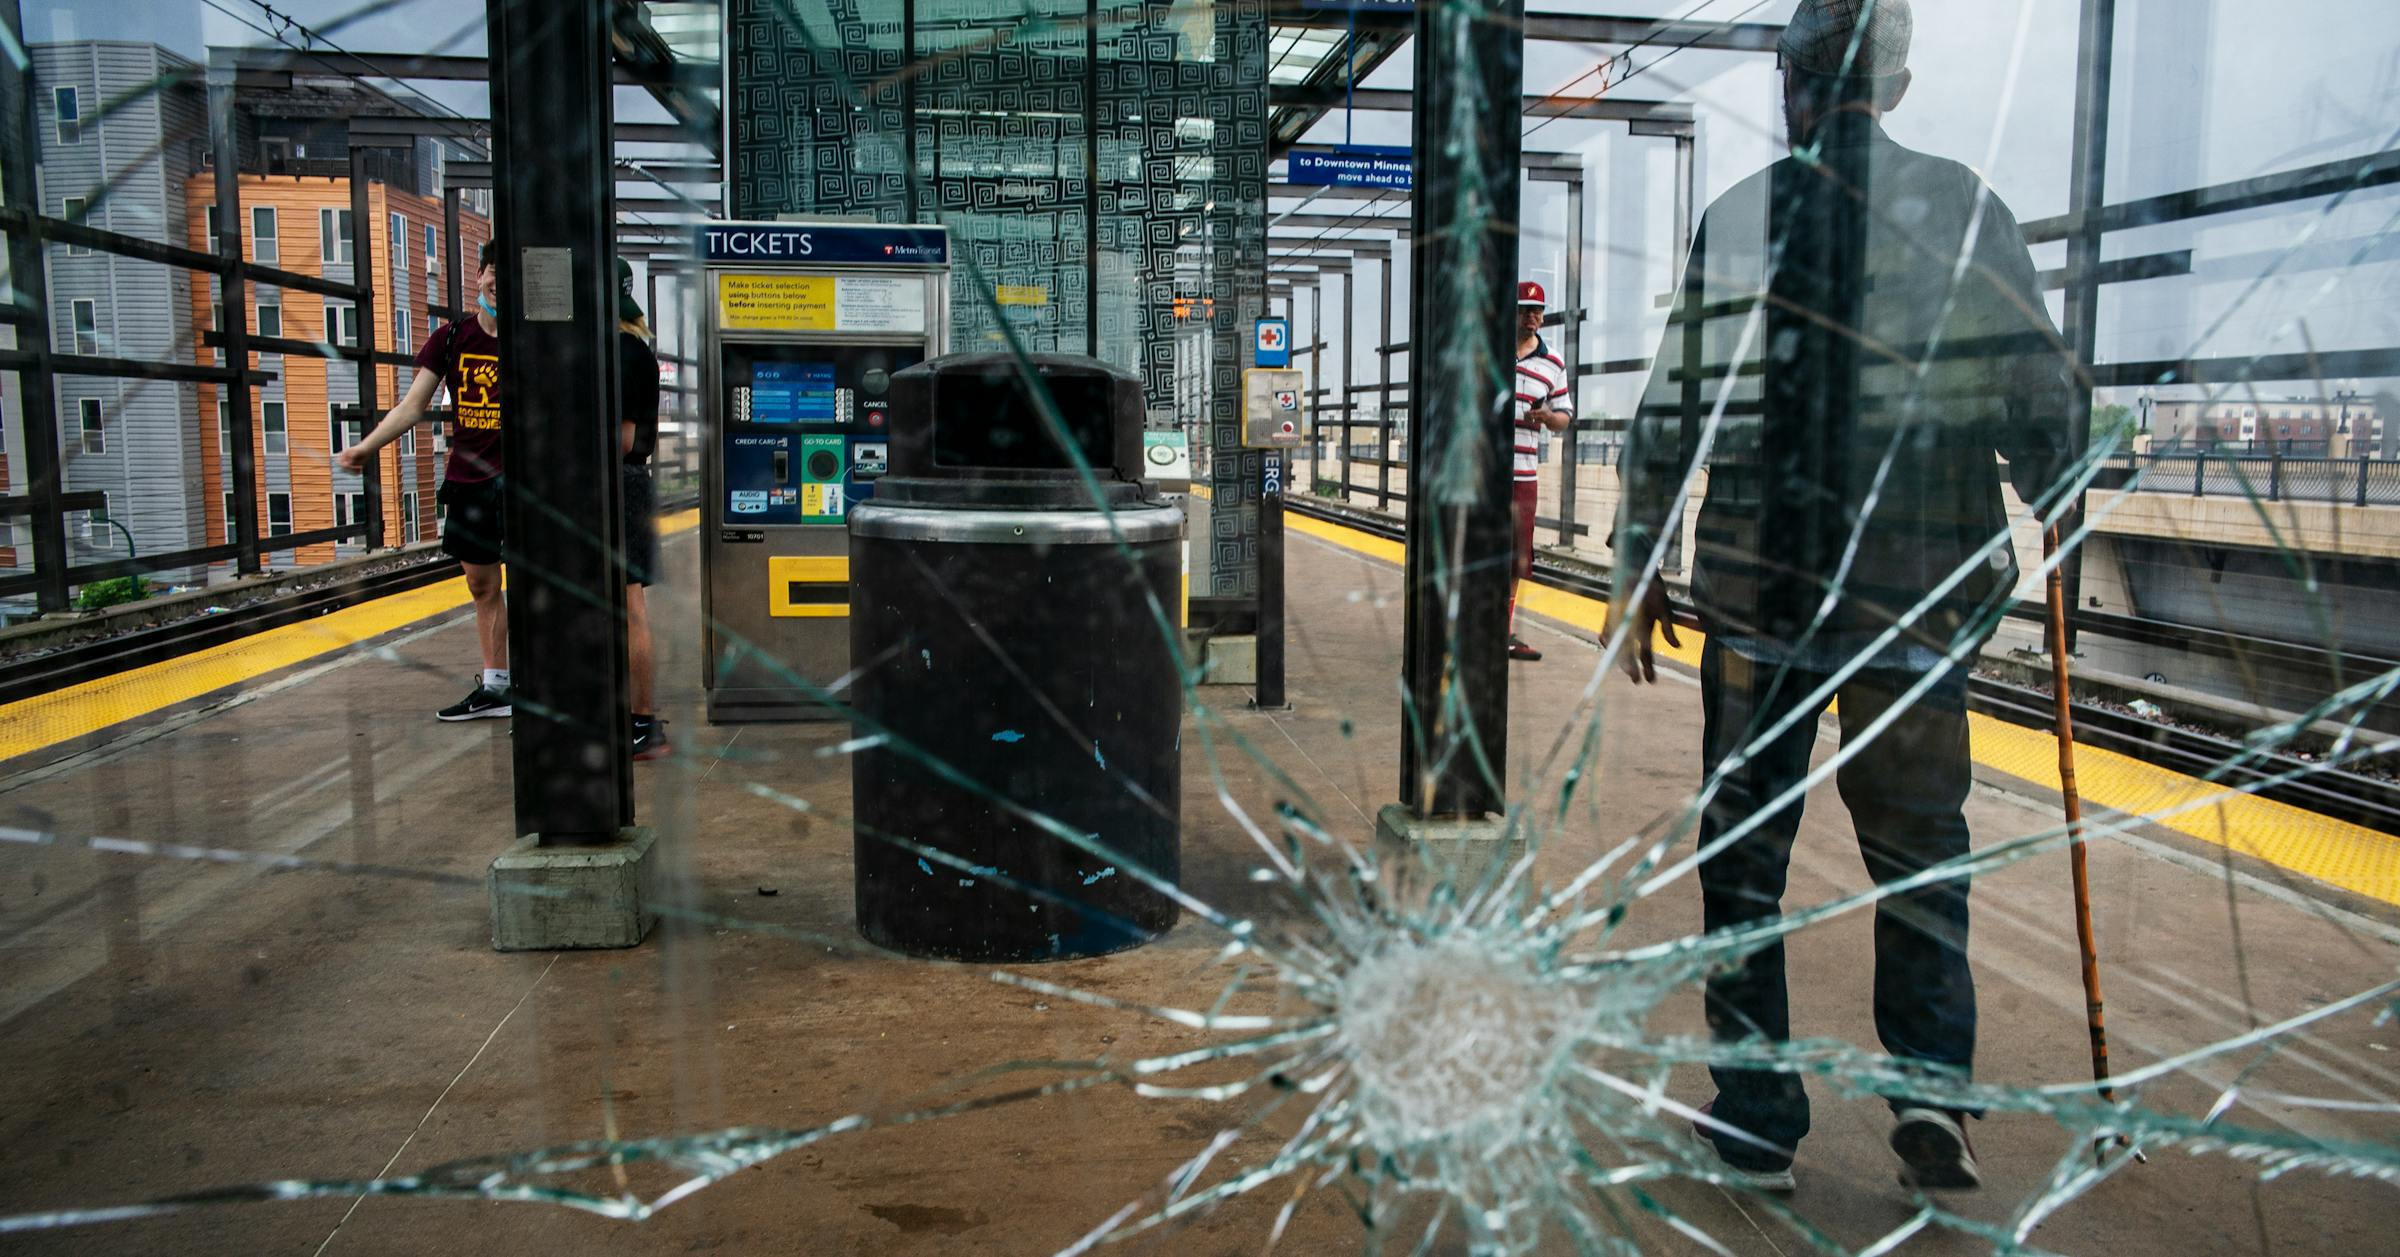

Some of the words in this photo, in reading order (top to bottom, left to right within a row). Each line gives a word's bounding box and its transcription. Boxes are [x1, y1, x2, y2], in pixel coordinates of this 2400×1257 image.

[1300, 158, 1311, 166] to
[1315, 157, 1370, 169] Downtown
[1374, 160, 1412, 173] Minnea
[1337, 173, 1362, 182] move
[1365, 173, 1392, 184] ahead
[1395, 175, 1405, 184] to
[705, 232, 812, 255] TICKETS
[728, 281, 749, 289] Make
[752, 281, 773, 289] ticket
[775, 282, 810, 290] selection
[728, 291, 749, 300] using
[752, 291, 781, 299] buttons
[757, 301, 791, 310] inserting
[793, 303, 826, 311] payment
[863, 401, 888, 409] CANCEL
[735, 438, 758, 446] CREDIT
[759, 438, 776, 446] CARD
[804, 438, 824, 446] GO-TO
[825, 438, 842, 446] CARD
